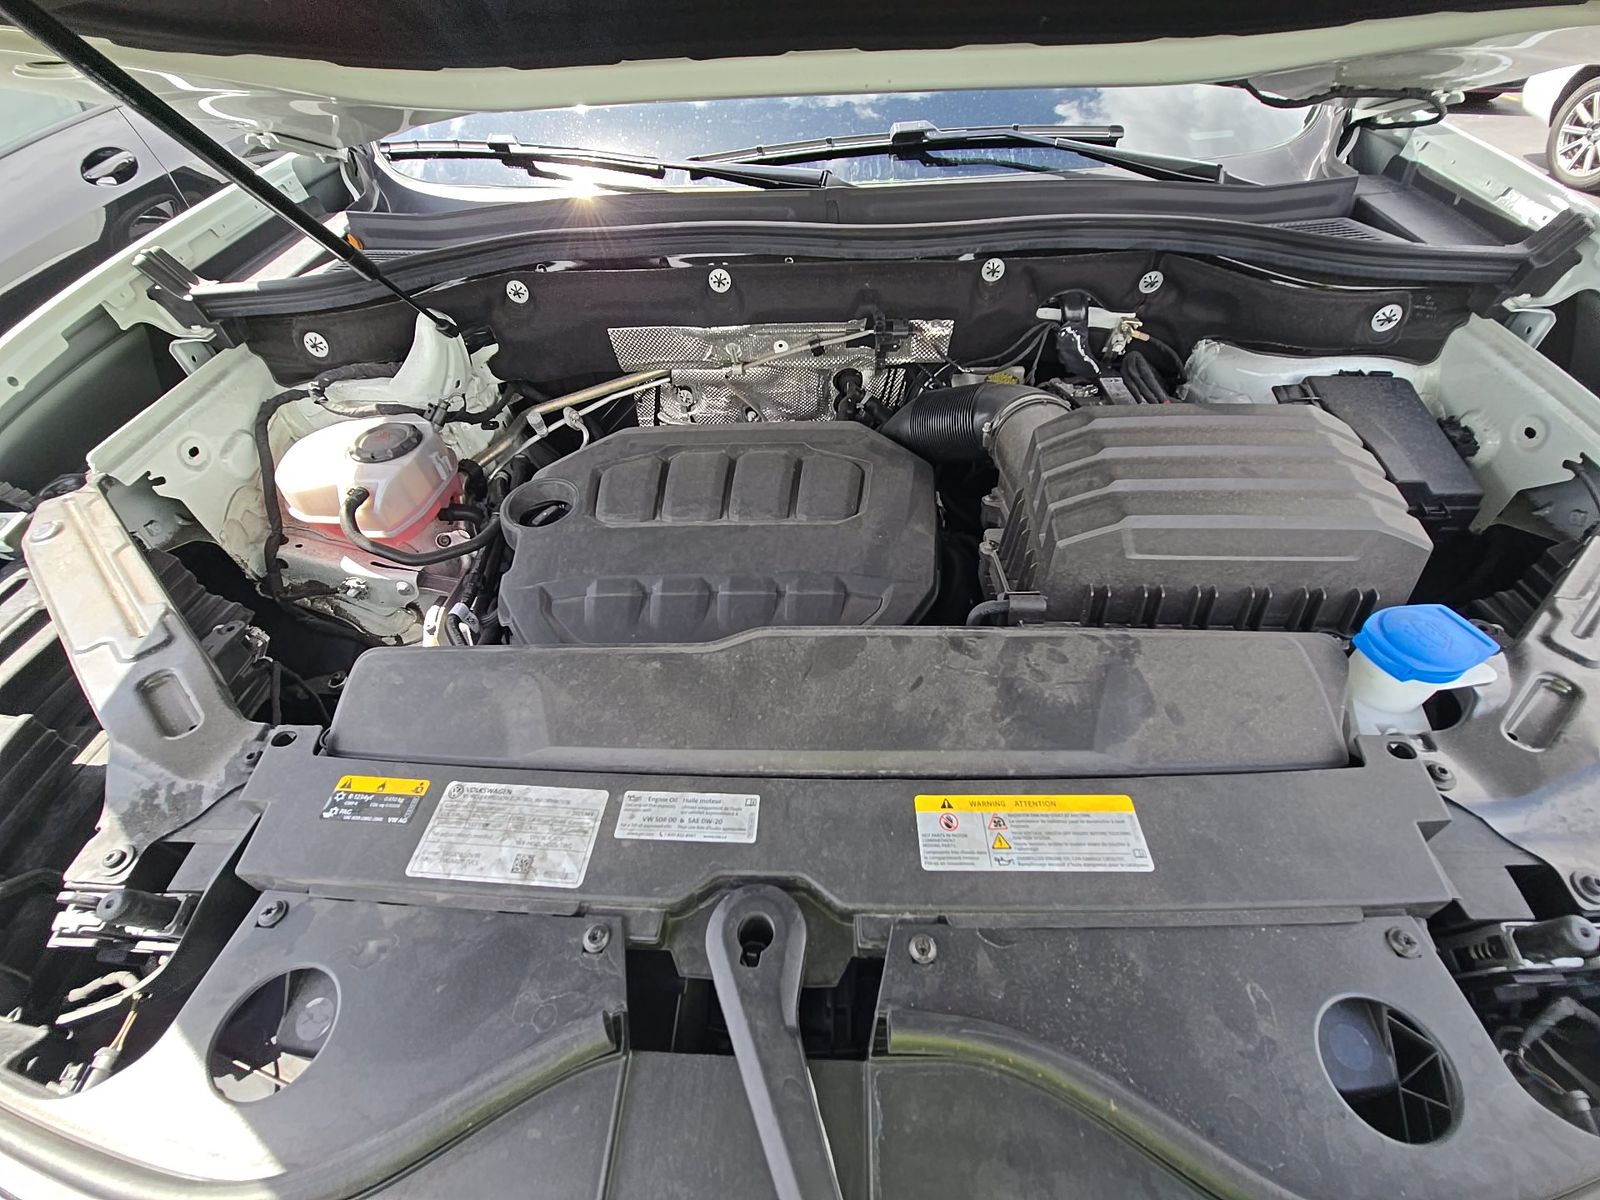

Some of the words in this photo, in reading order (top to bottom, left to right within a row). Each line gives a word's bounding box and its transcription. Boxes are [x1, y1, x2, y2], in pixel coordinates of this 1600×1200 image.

[466, 786, 513, 795] VOLKSWAGEN
[648, 796, 668, 804] Engine
[968, 800, 1006, 808] WARNING
[1014, 800, 1057, 808] ATTENTION
